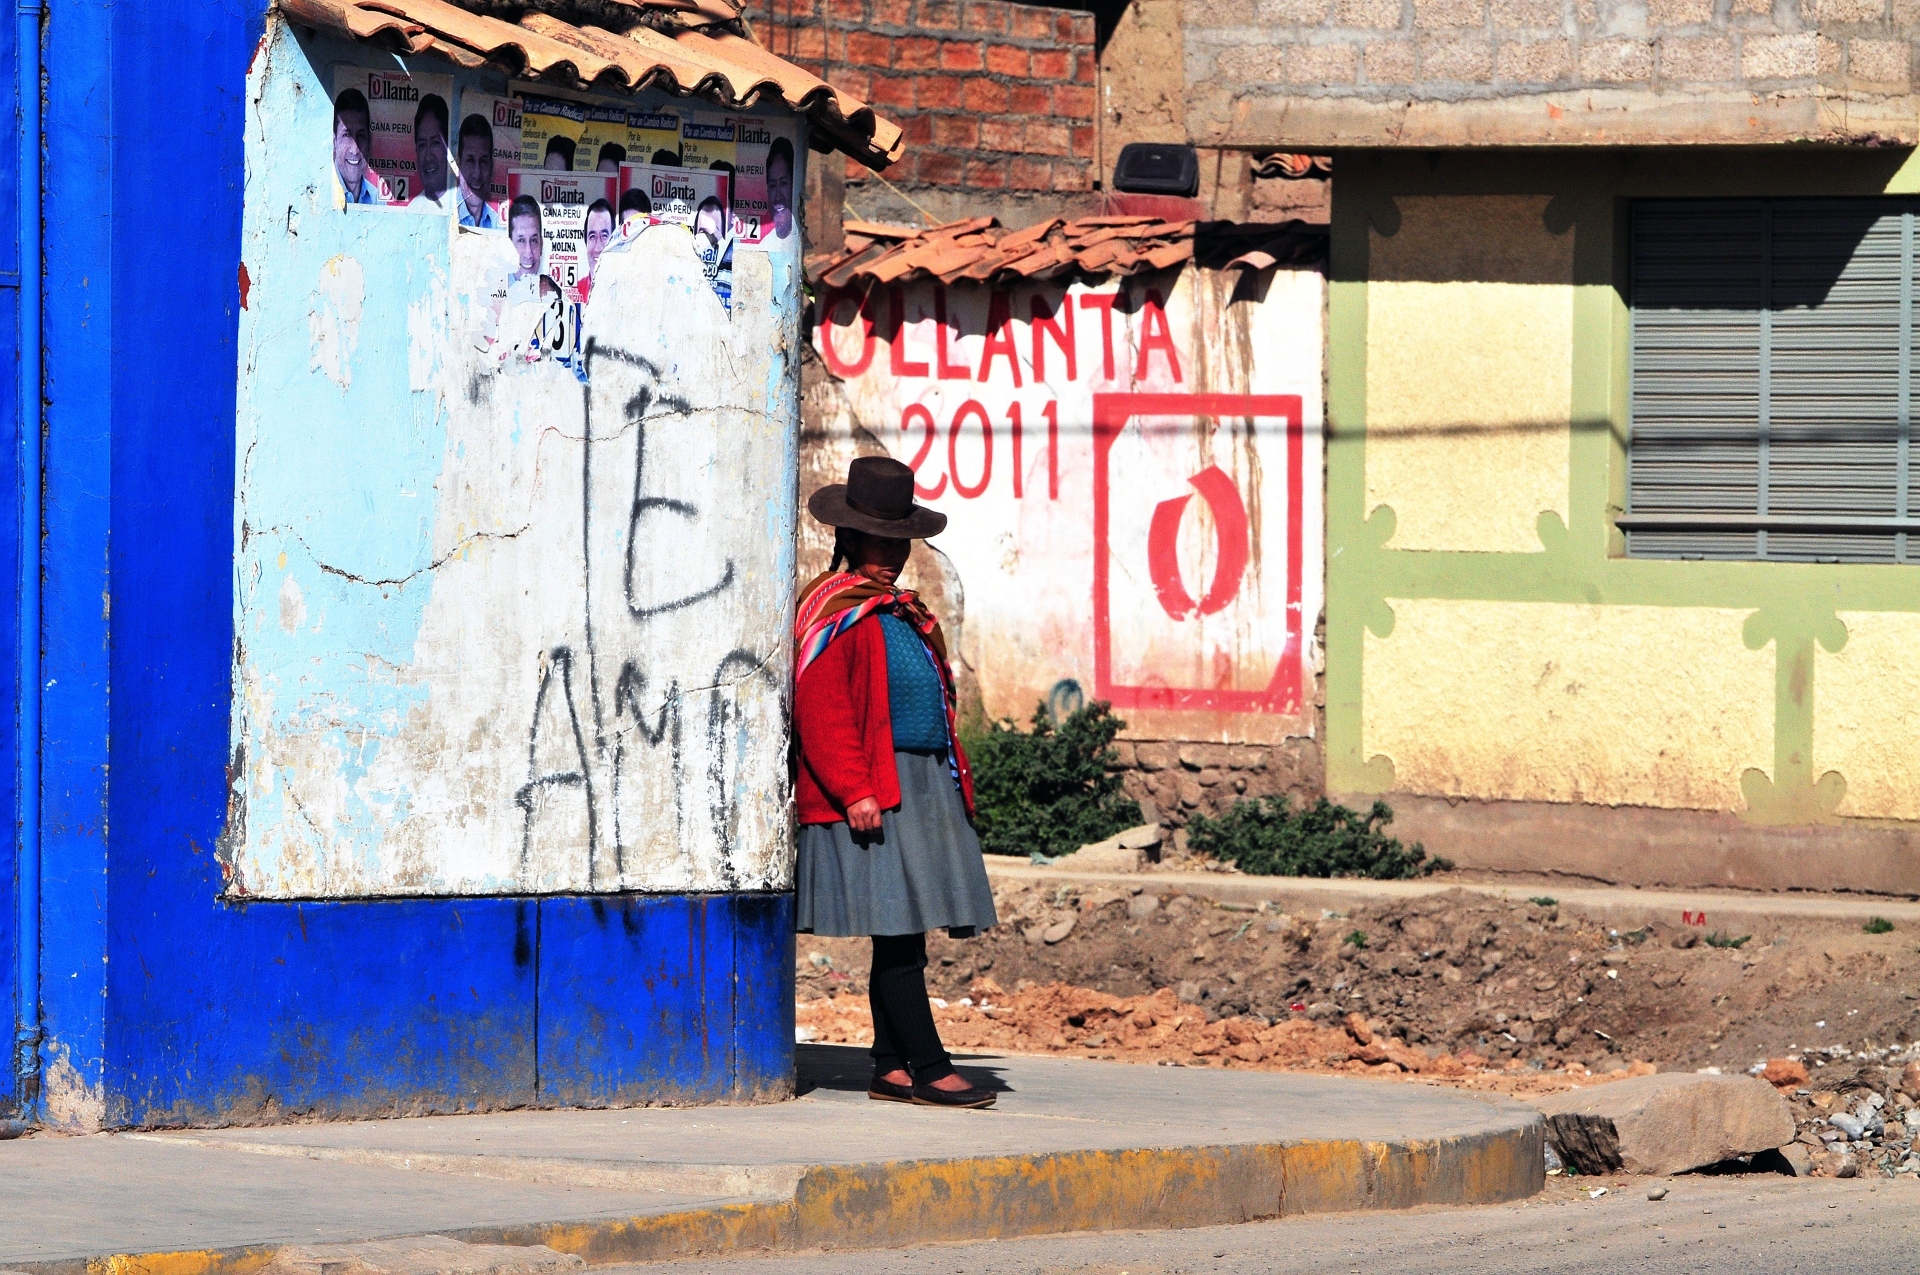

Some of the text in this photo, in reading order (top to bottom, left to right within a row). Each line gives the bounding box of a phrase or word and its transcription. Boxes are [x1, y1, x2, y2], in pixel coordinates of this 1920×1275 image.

[369, 73, 419, 102] Ollanta
[493, 101, 522, 129] Olla
[560, 105, 585, 121] Radical
[370, 122, 412, 134] GANA PERÚ
[628, 131, 636, 141] Por
[627, 142, 645, 152] defensa
[684, 142, 692, 152] Por
[493, 149, 512, 160] GANA
[684, 153, 701, 163] defensa
[369, 158, 416, 171] RUBEN COA
[746, 164, 764, 175] PERÚ
[490, 184, 507, 195] RUB
[541, 180, 585, 204] Ollanta
[651, 174, 696, 201] Ollanta
[653, 202, 692, 215] GANA PERÚ
[735, 200, 768, 210] BEN COA
[543, 208, 581, 219] GANA PERÚ
[551, 241, 576, 252] MOLINA
[820, 285, 1183, 388] OLLANTA
[902, 399, 1058, 500] 2011
